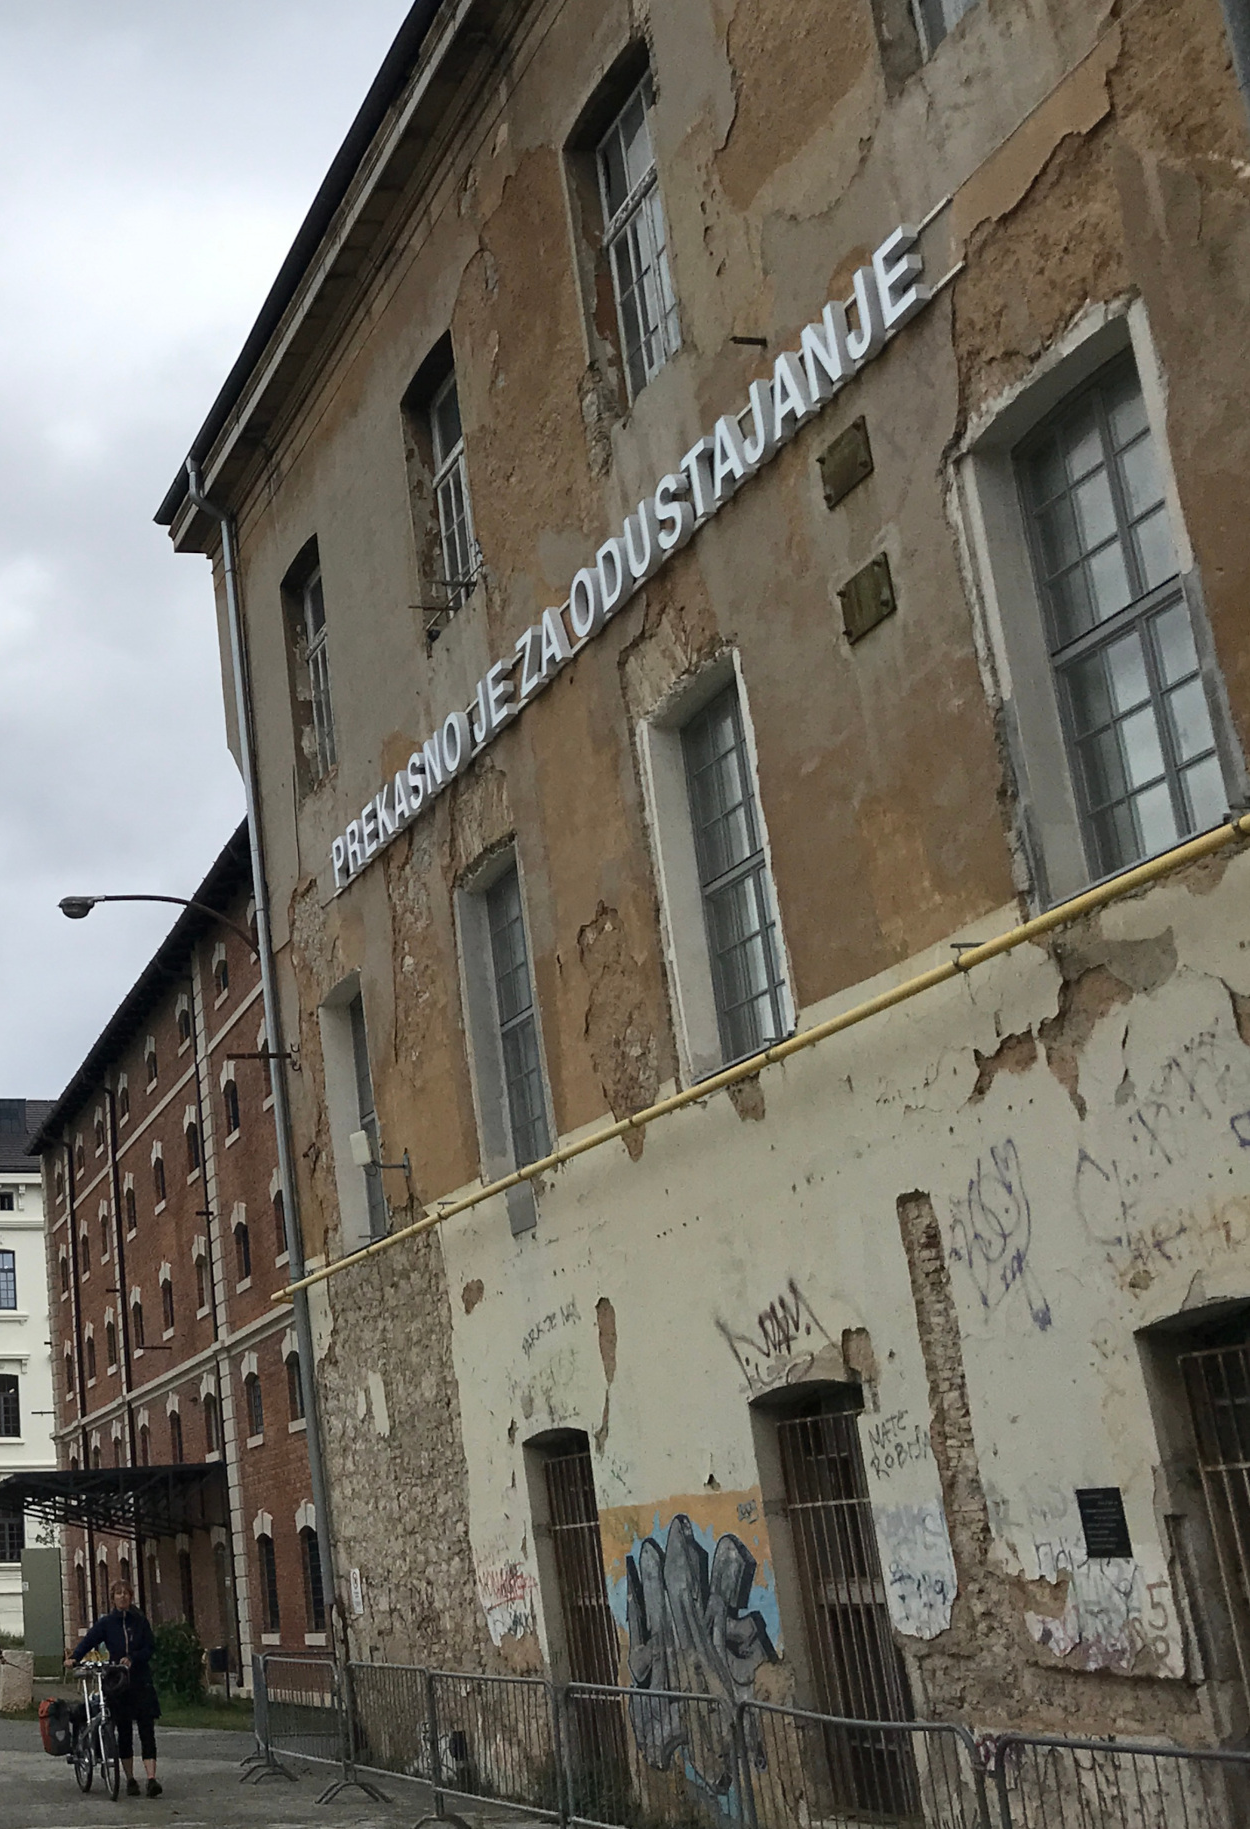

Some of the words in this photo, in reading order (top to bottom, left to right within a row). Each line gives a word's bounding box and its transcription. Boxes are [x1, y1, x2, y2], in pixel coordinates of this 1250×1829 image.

[331, 711, 470, 889] PREKASNO
[473, 658, 518, 744] JE
[515, 606, 574, 700] ZA
[568, 223, 932, 638] ODUSTAJANJE
